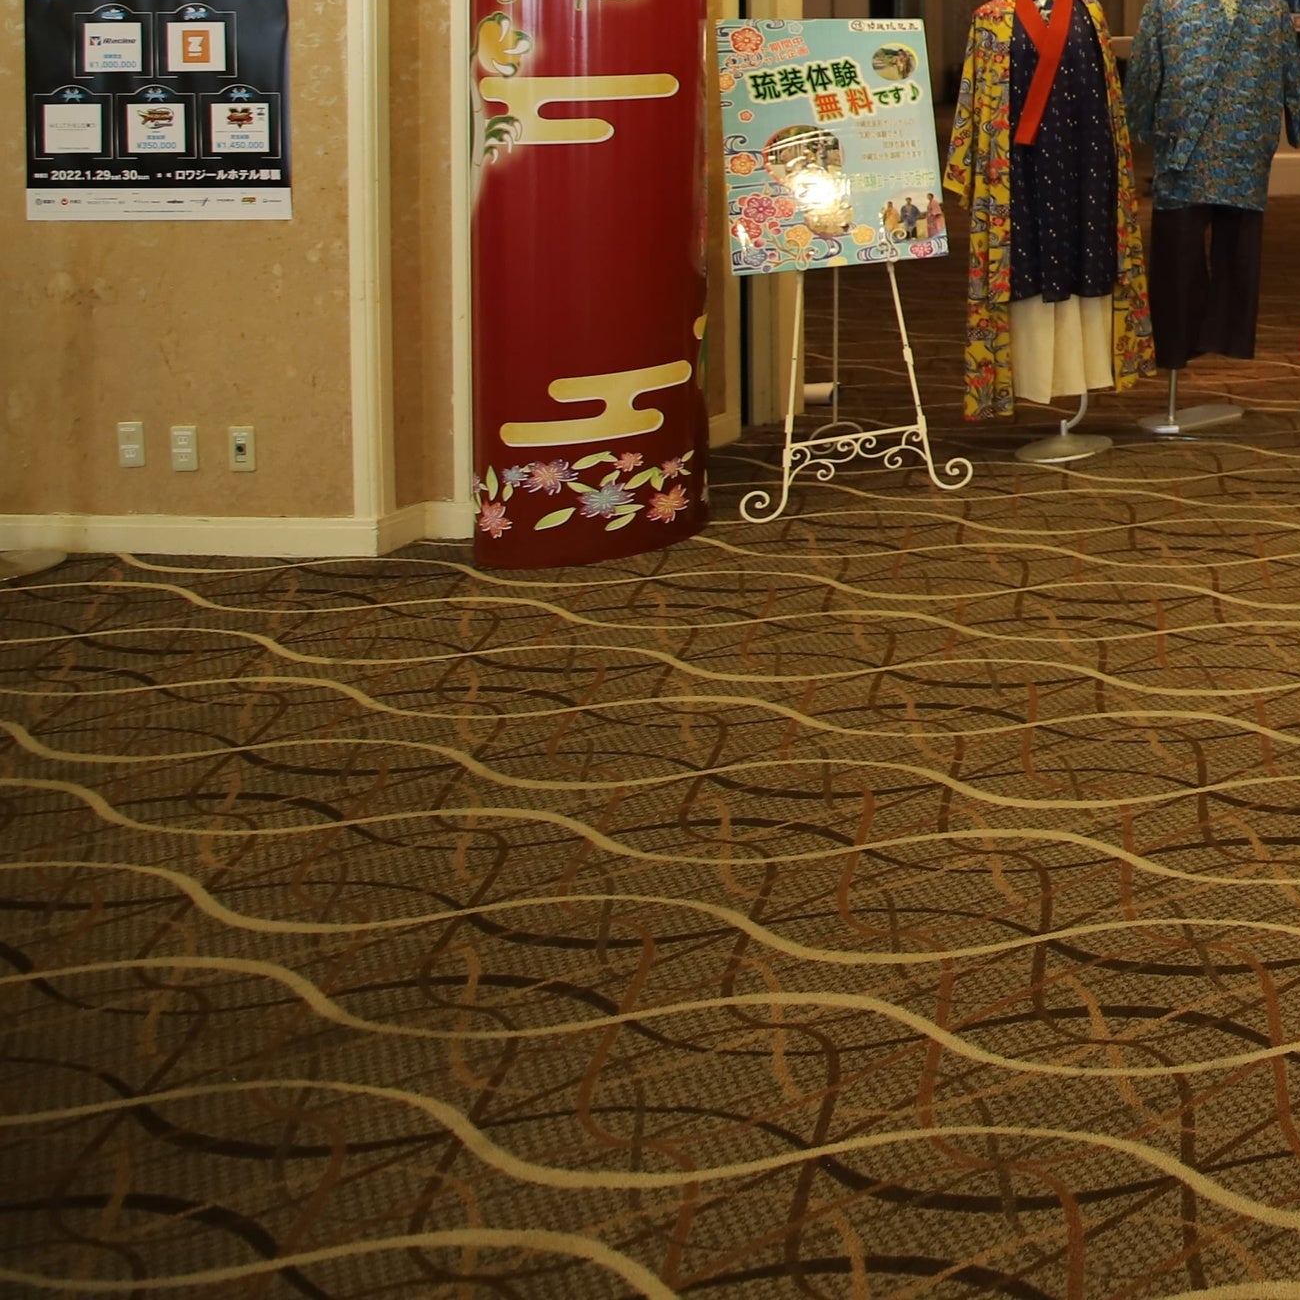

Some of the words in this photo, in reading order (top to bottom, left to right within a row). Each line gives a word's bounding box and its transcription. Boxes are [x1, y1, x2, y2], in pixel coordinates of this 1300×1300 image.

[748, 59, 861, 100] 琉装体験
[136, 140, 177, 150] ¥350,000
[216, 140, 265, 150] ¥1,450,000
